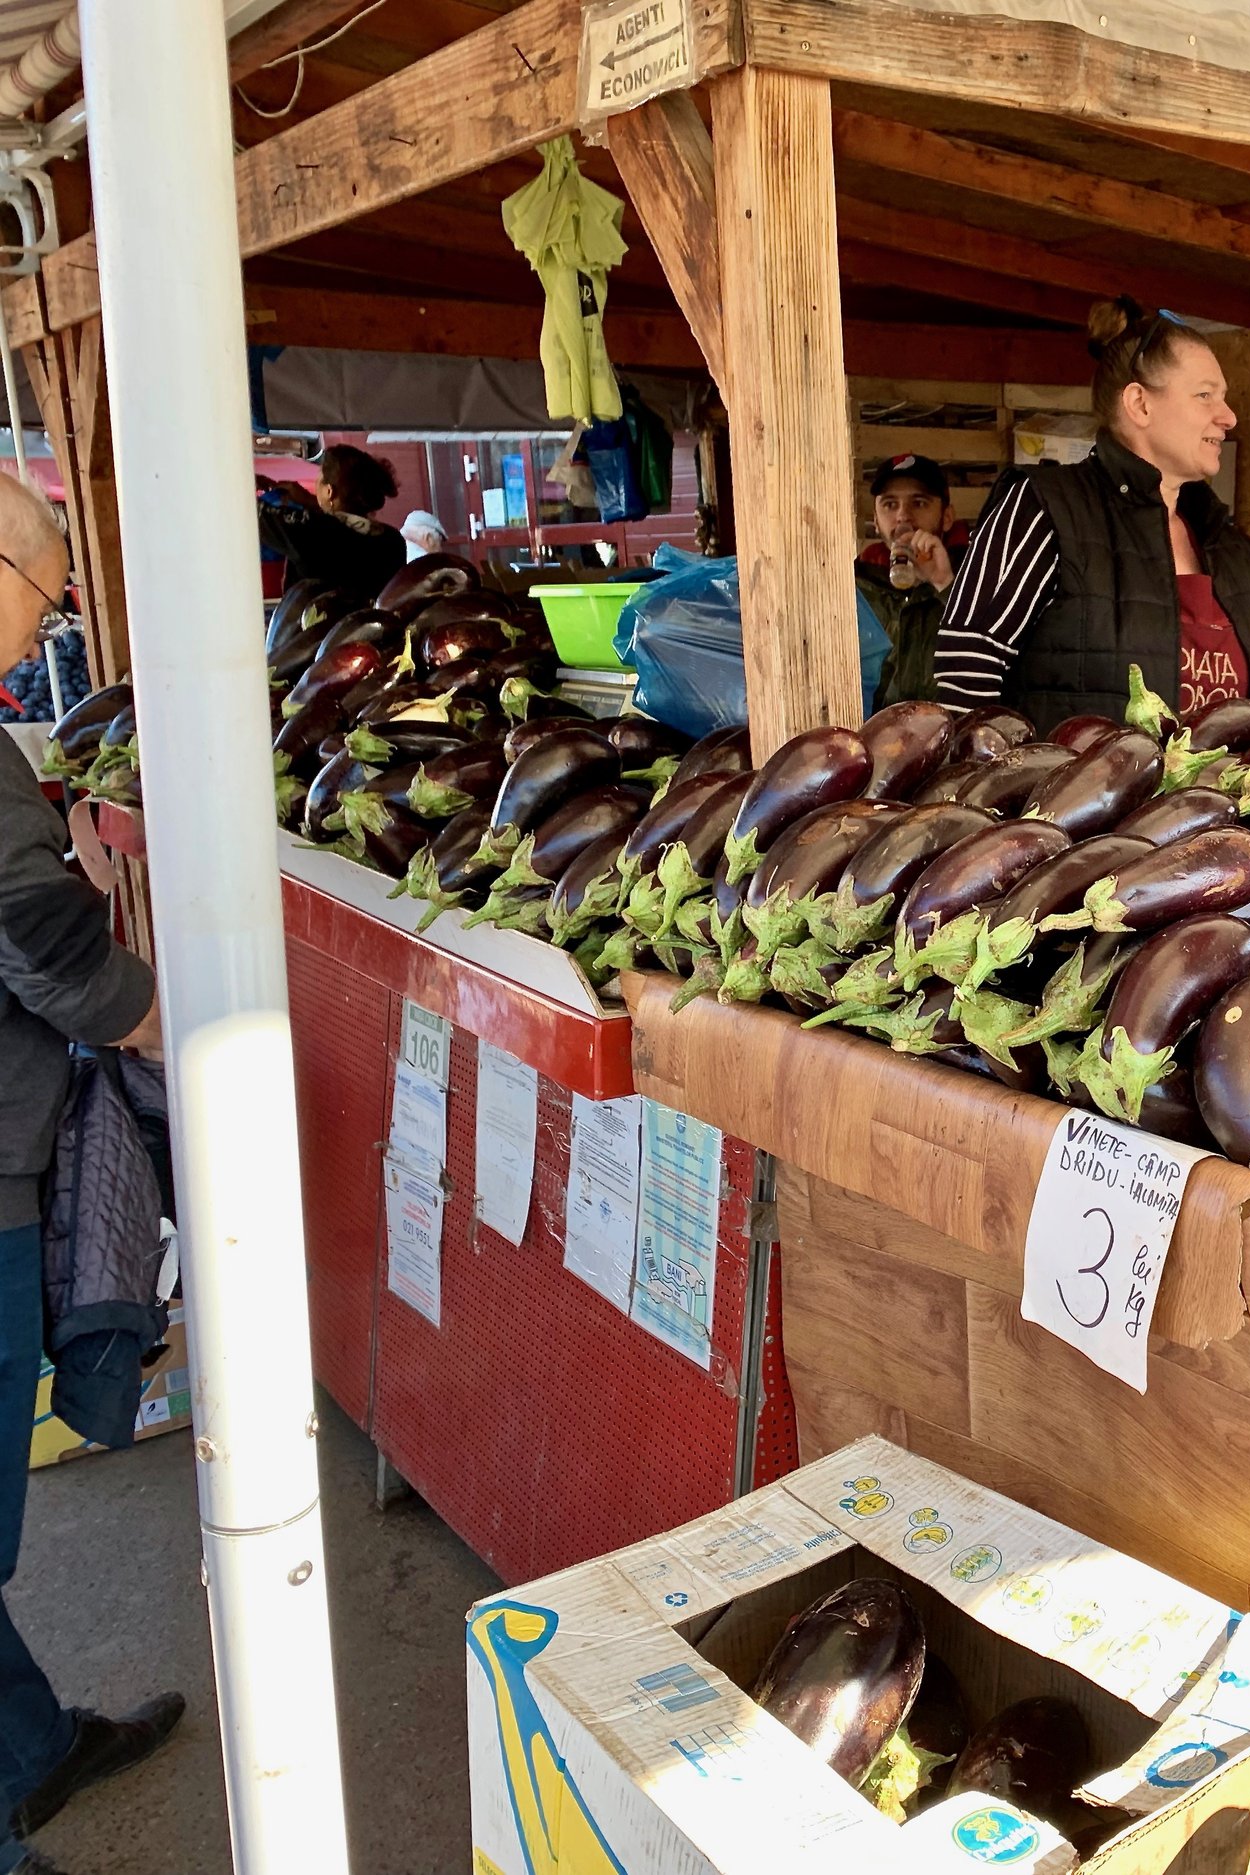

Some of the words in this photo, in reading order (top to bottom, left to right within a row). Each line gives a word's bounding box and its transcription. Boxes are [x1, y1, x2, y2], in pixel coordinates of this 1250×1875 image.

[600, 48, 680, 100] ECONOMICI
[411, 1031, 440, 1075] 106
[666, 1263, 682, 1281] BANI
[1055, 1207, 1115, 1329] 3
[1131, 1244, 1162, 1286] lei
